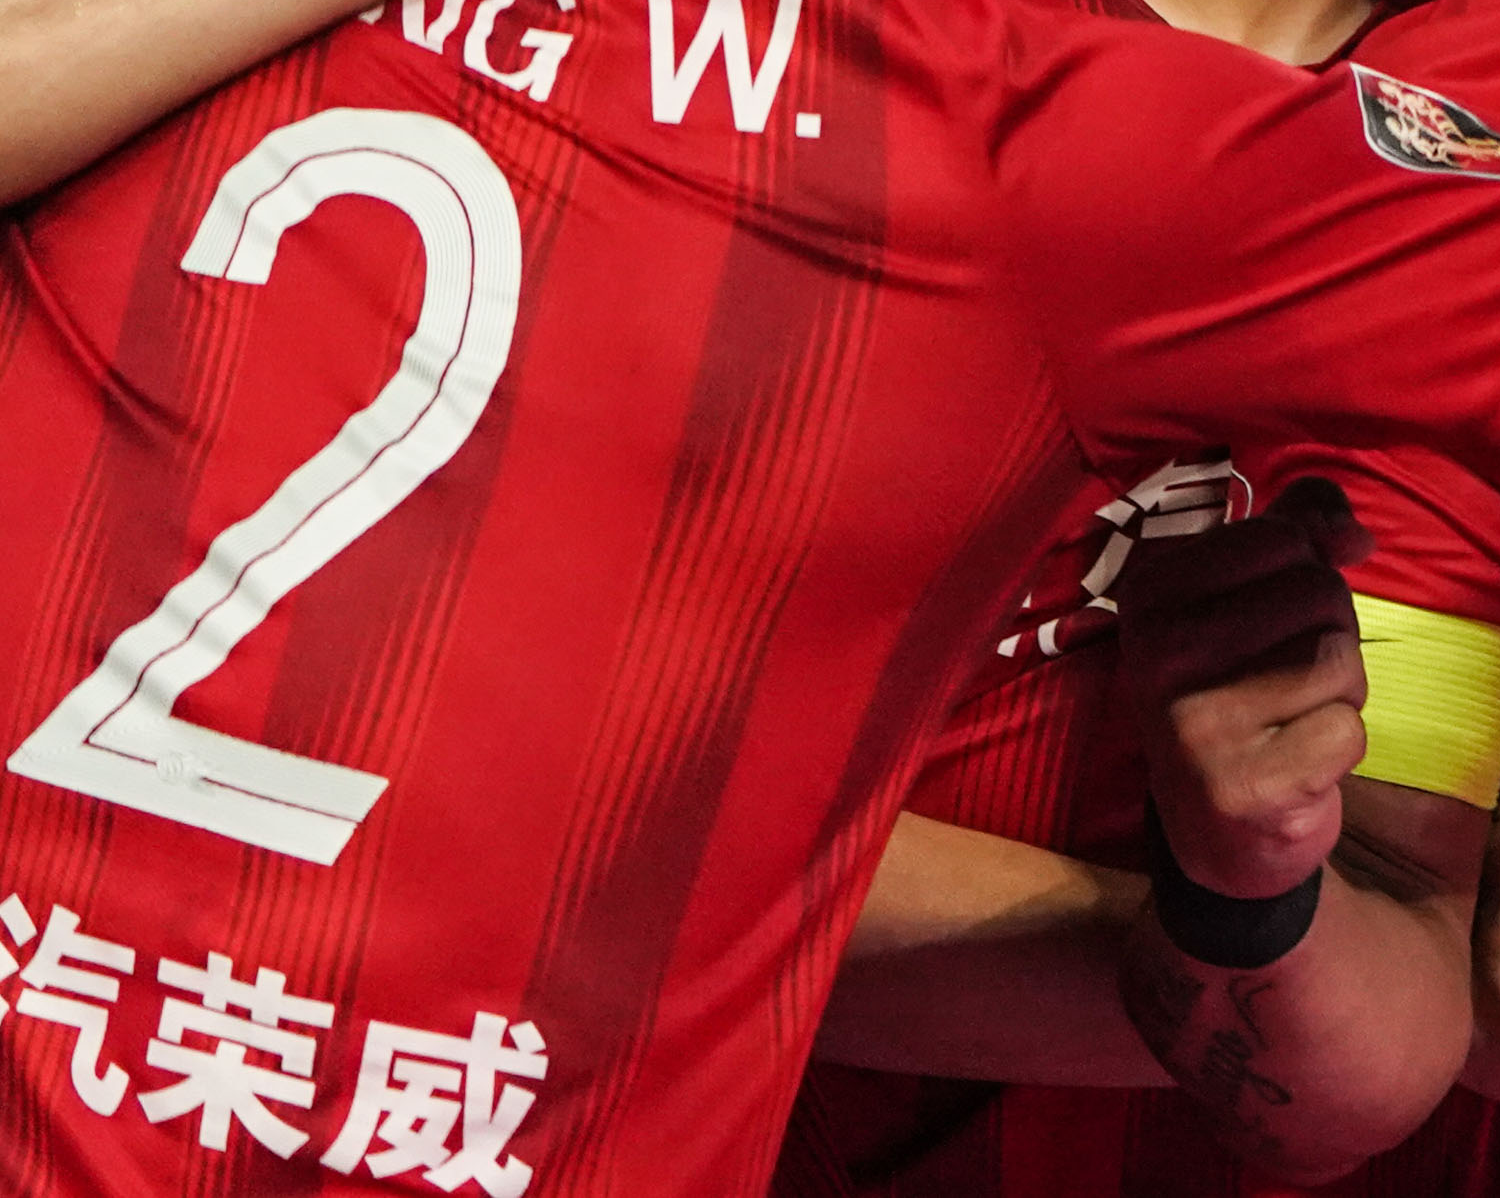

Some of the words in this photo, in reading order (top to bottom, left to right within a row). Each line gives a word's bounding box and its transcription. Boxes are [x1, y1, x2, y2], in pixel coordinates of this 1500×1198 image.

[6, 108, 522, 866] 2
[0, 894, 548, 1198] 汽荣威
